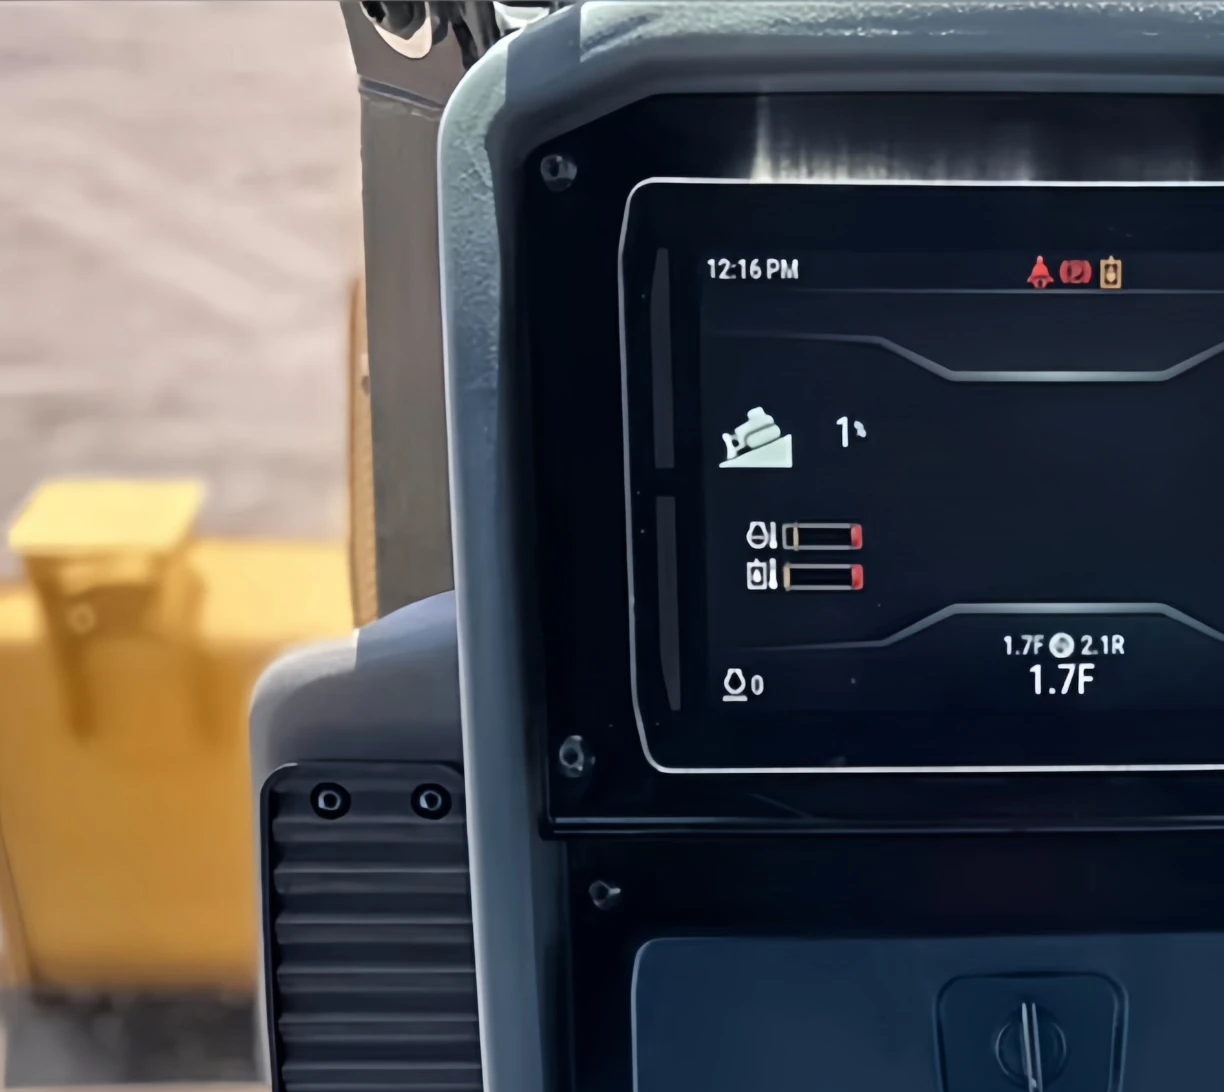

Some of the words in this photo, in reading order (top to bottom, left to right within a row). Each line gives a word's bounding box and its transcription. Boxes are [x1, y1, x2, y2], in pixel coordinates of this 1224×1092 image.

[707, 258, 762, 280] 12:16
[766, 258, 799, 280] PM
[1003, 634, 1045, 656] 1.7F
[1080, 633, 1125, 656] 2.1R
[750, 674, 764, 696] 0
[1029, 662, 1096, 695] 1.7F
